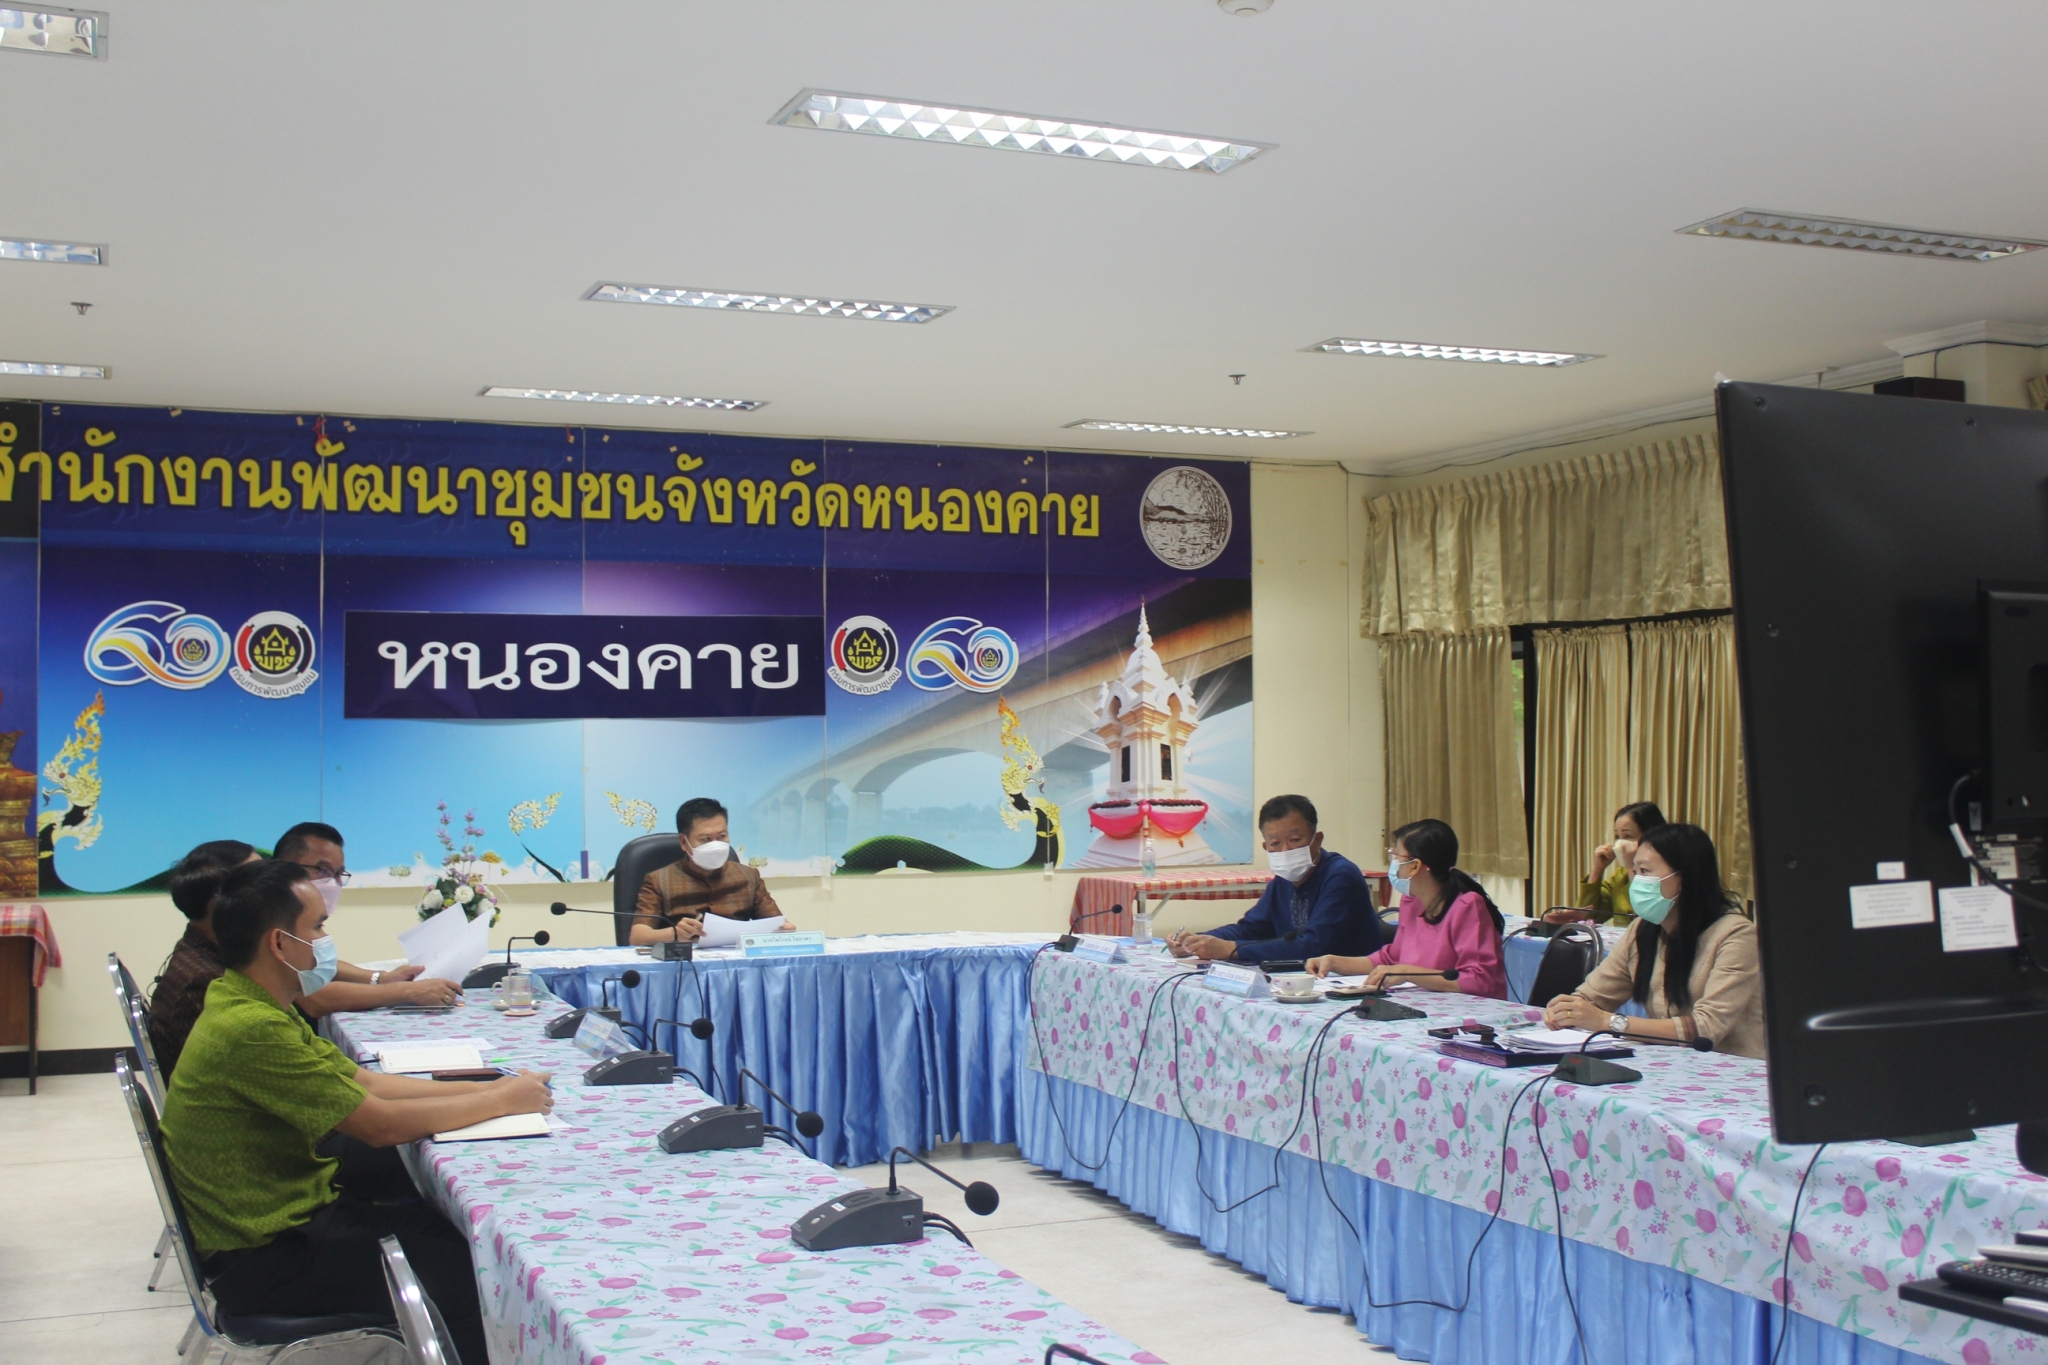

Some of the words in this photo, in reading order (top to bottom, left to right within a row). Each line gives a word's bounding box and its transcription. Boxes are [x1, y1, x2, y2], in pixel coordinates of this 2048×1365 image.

[378, 640, 799, 691] หนองคาย
[231, 668, 316, 697] กรมการพัฒนาชุมชน
[829, 668, 901, 694] กรมการพัฒนาชุมชน
